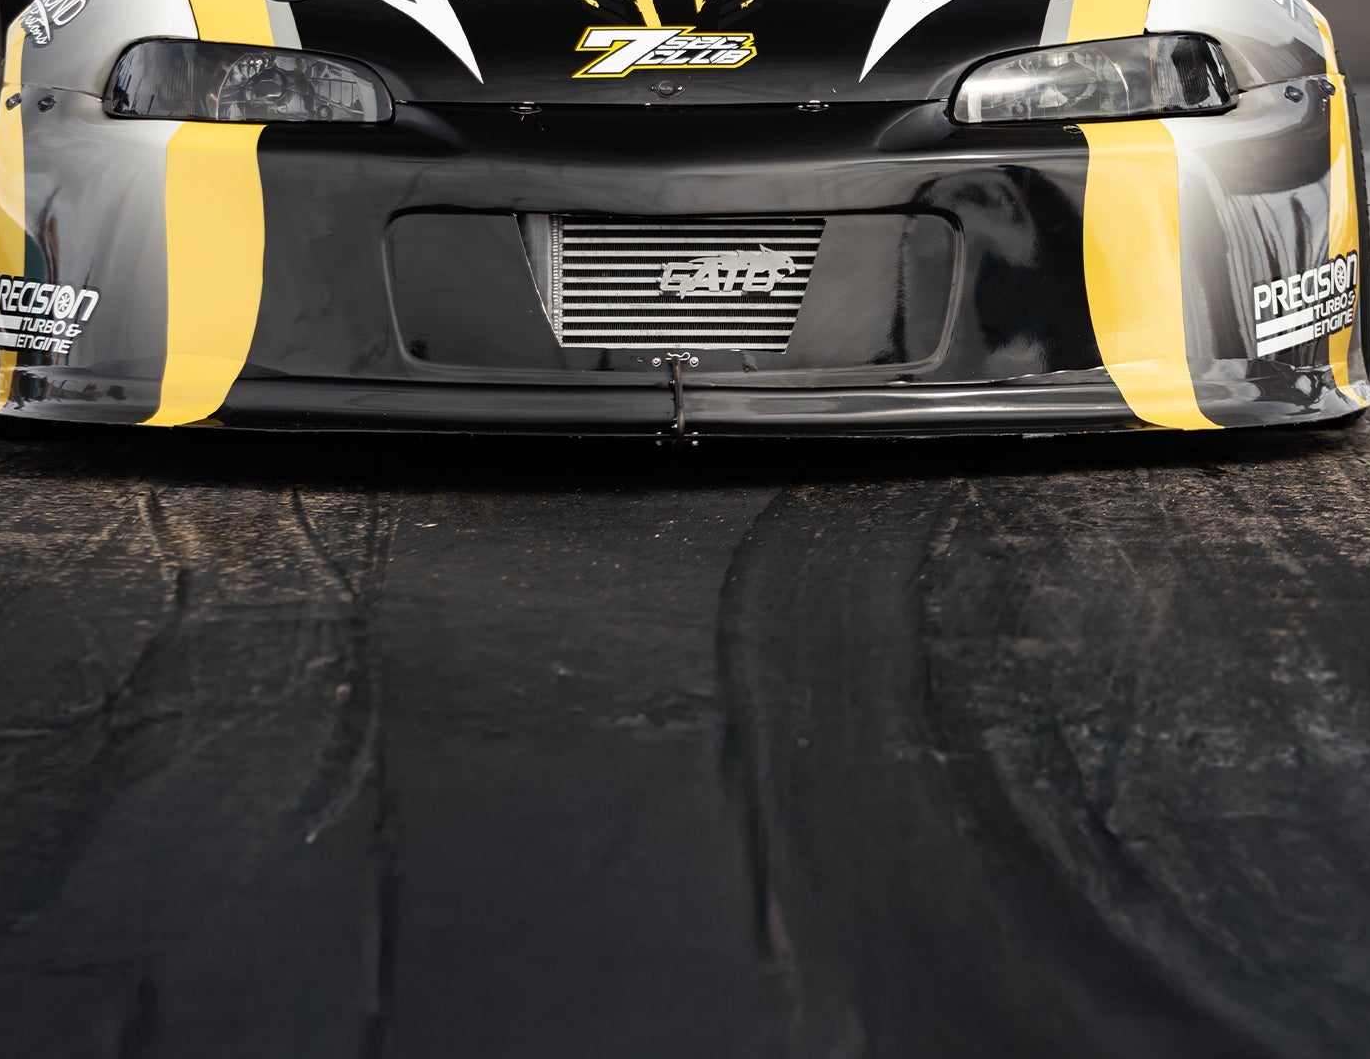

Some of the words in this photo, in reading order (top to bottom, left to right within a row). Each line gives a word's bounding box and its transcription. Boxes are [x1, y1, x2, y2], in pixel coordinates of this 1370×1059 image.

[582, 29, 683, 74] 7
[657, 36, 748, 50] SEC
[634, 49, 752, 65] CLUB
[659, 260, 778, 299] GATO
[1313, 292, 1348, 319] TURBO
[21, 316, 67, 335] TURBO
[65, 323, 83, 337] &
[1313, 308, 1354, 338] ENGINE
[16, 334, 74, 354] ENGINE
